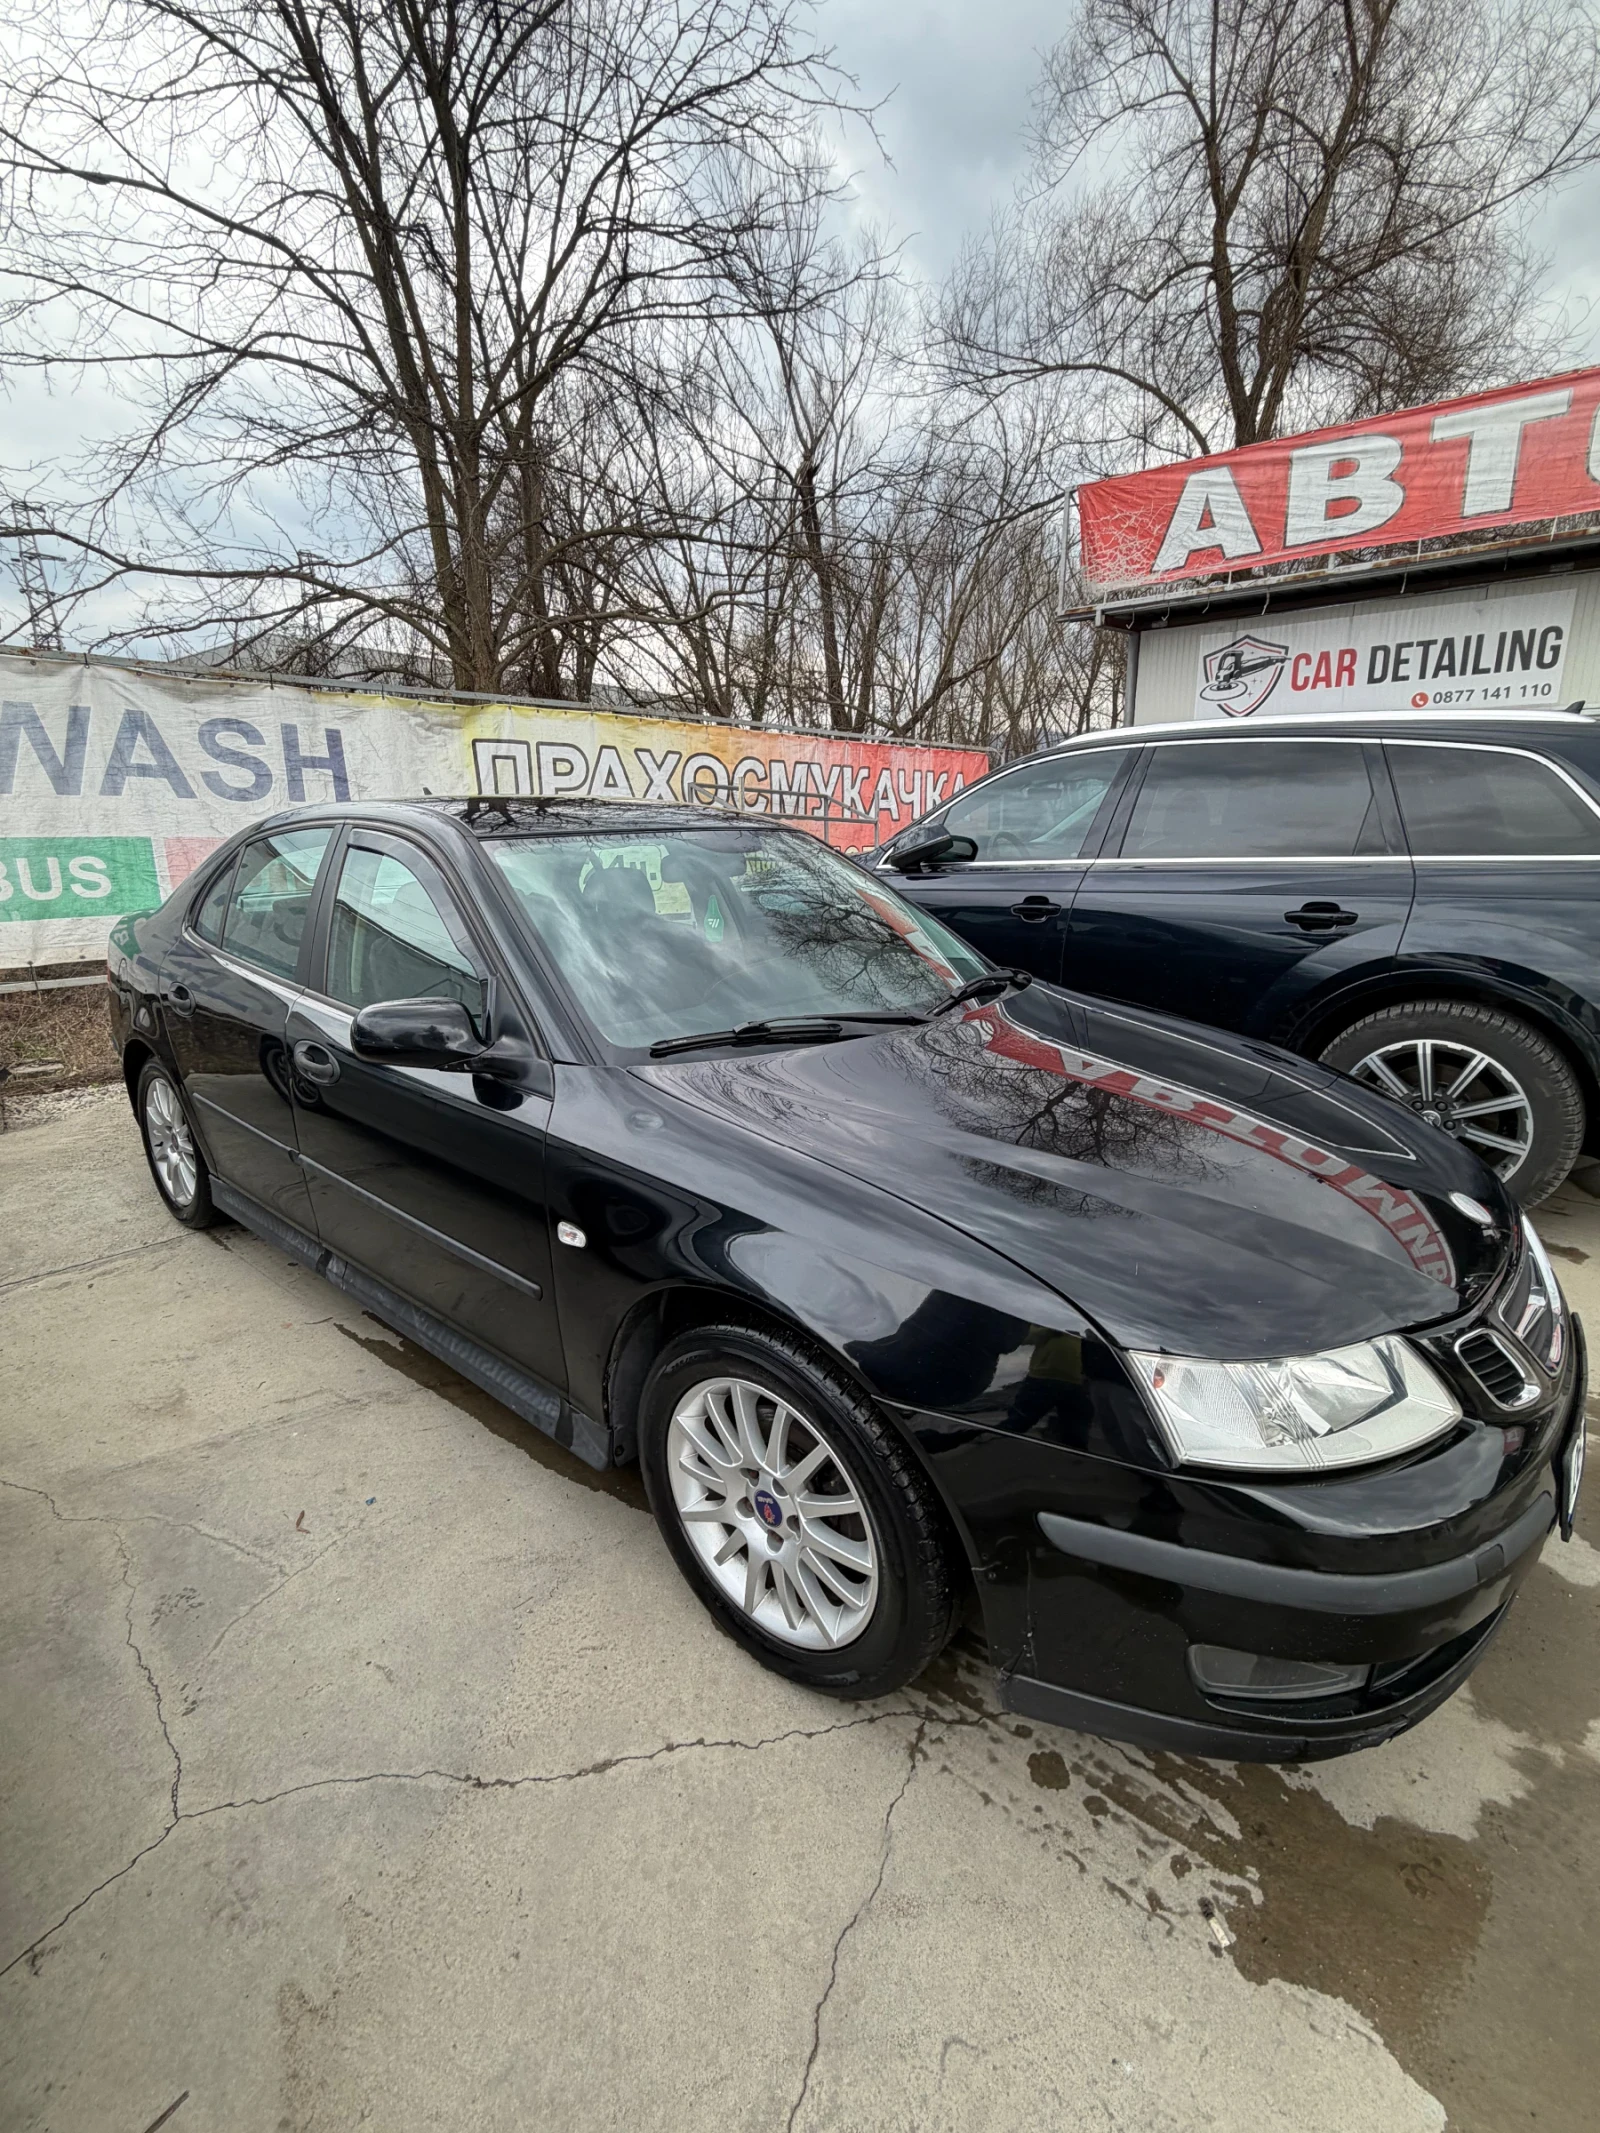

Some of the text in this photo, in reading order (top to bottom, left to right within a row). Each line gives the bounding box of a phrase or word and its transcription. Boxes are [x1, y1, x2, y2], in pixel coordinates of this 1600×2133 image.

[1151, 387, 1600, 573] АВТ
[1290, 625, 1564, 692] CAR DETAILING
[1433, 682, 1552, 705] 0877 141 110
